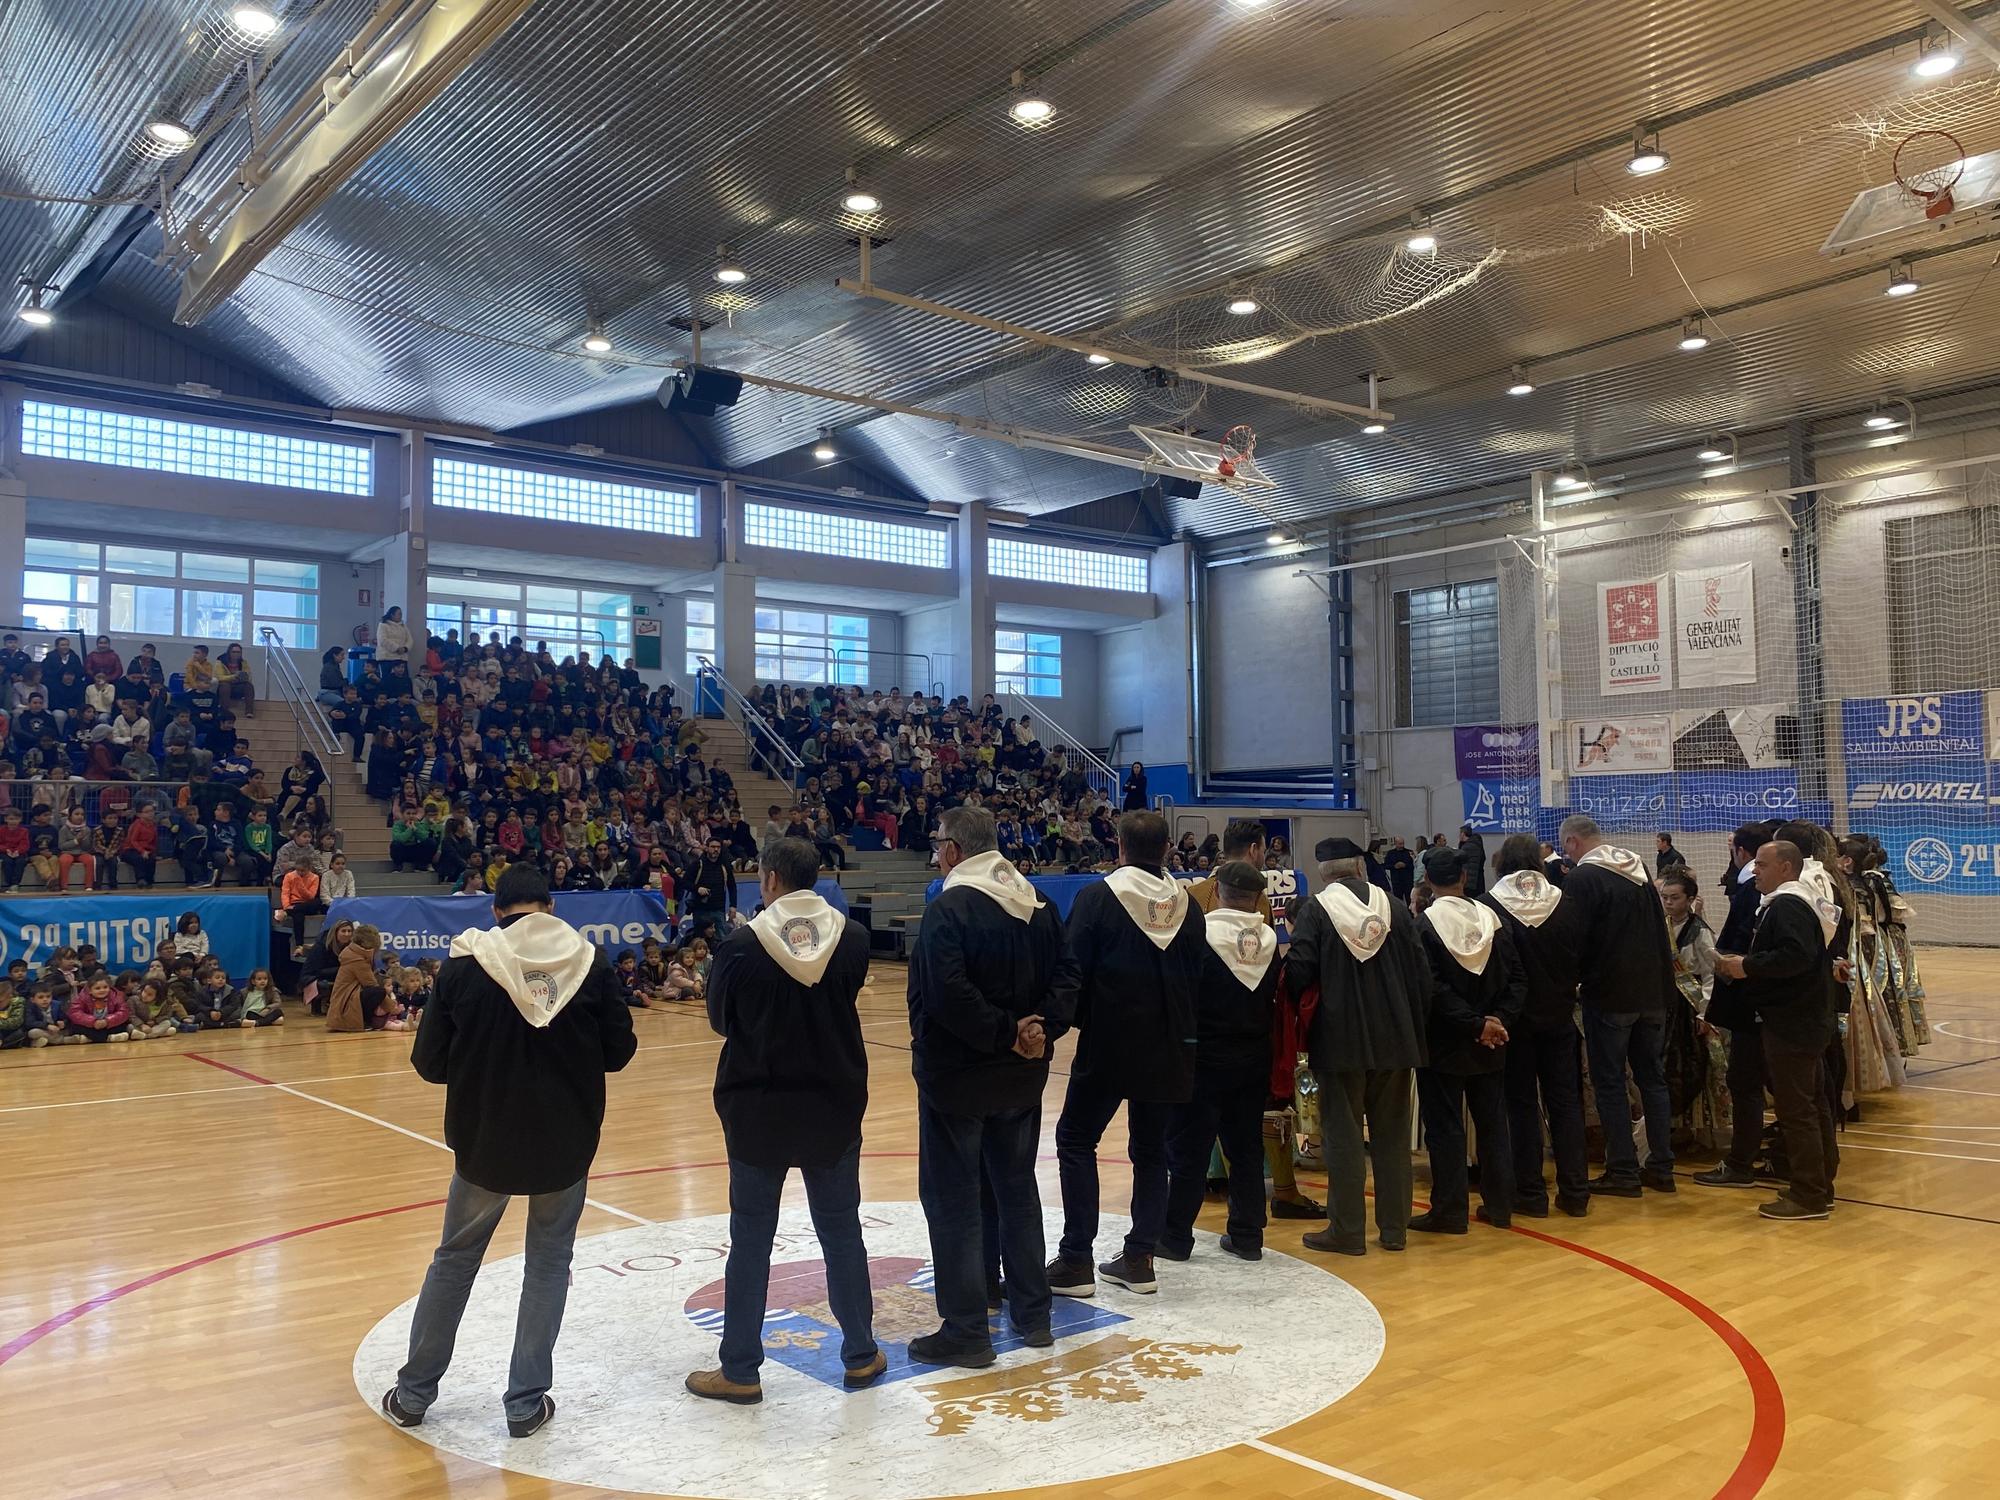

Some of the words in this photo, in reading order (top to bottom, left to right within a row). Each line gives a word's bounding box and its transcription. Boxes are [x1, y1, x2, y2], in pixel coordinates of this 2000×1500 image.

[1686, 618, 1741, 637] GENERALITAT
[1688, 633, 1742, 651] VALENCIANA
[1609, 657, 1616, 667] D
[1653, 652, 1659, 662] E
[1877, 697, 1941, 737] JPS
[1465, 751, 1482, 759] JOSE
[1484, 750, 1515, 758] ANTONIO
[1846, 738, 1980, 754] SALUDAMBIENTAL
[1580, 778, 1666, 812] brizza
[1681, 792, 1758, 809] ESTUDIO
[1763, 787, 1797, 809] G2
[1881, 783, 1985, 800] NOVATEL
[69, 916, 182, 964] FUTSA
[379, 929, 450, 950] Peñísc
